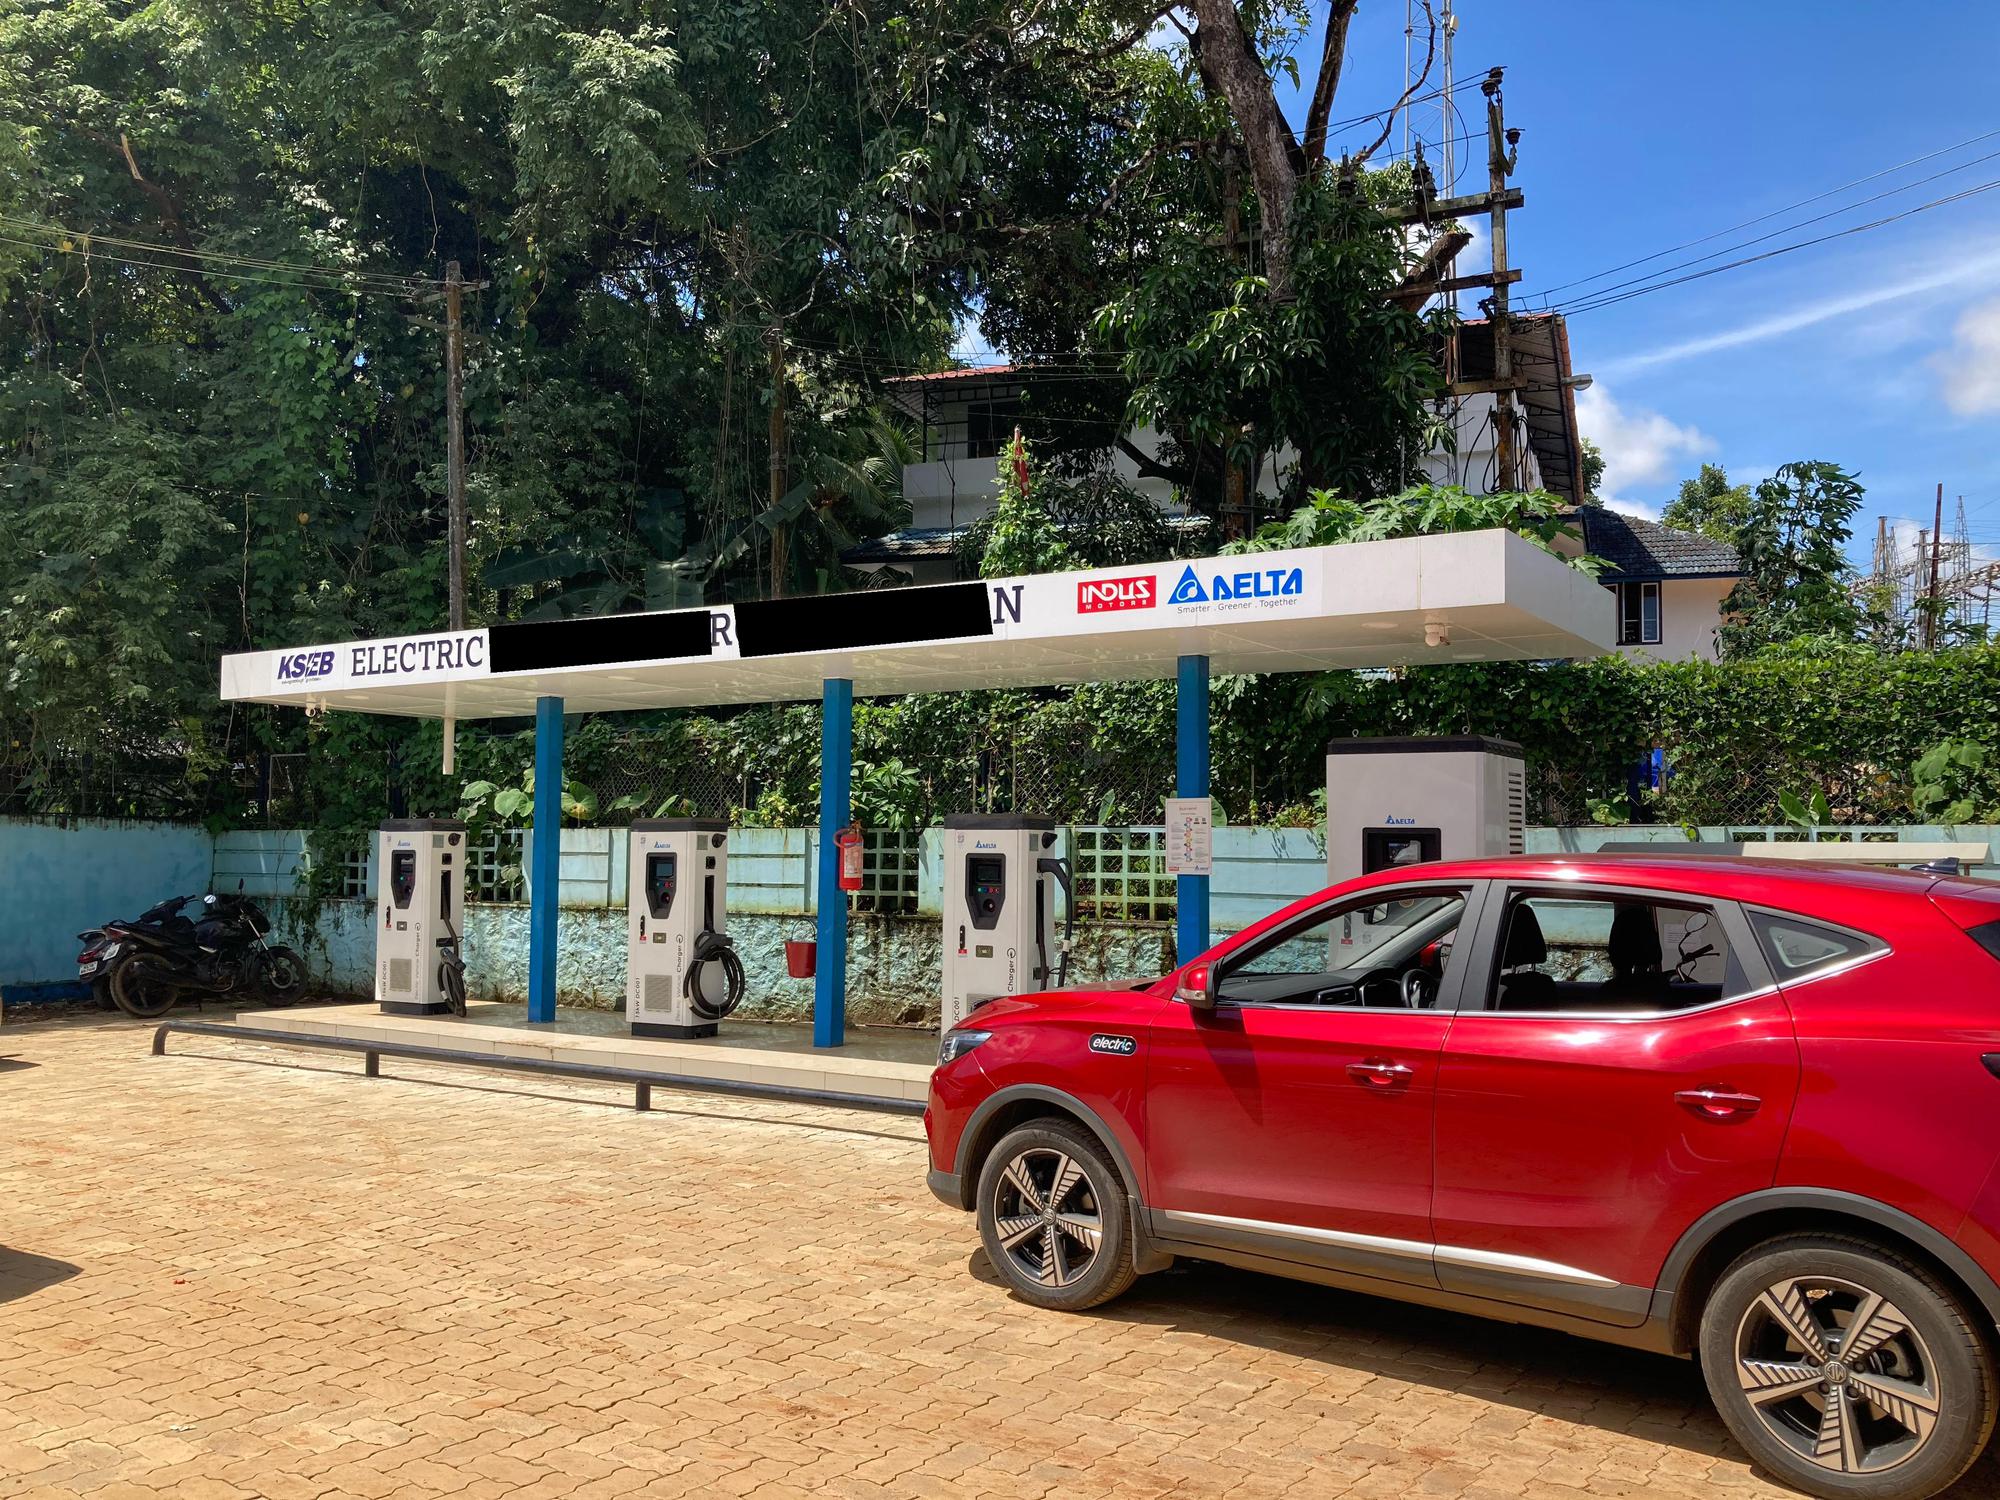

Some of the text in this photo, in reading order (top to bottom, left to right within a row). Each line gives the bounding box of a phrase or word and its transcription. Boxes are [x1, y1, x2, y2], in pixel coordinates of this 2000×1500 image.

[1081, 579, 1151, 604] INDUS
[1212, 567, 1303, 601] DELTA
[1085, 599, 1147, 610] MOTORS
[1177, 598, 1298, 614] Smarter Greener Together
[277, 650, 336, 680] KSEB
[351, 635, 484, 677] ELECTRIC
[1007, 960, 1016, 992] Charger
[1093, 1037, 1132, 1052] electric
